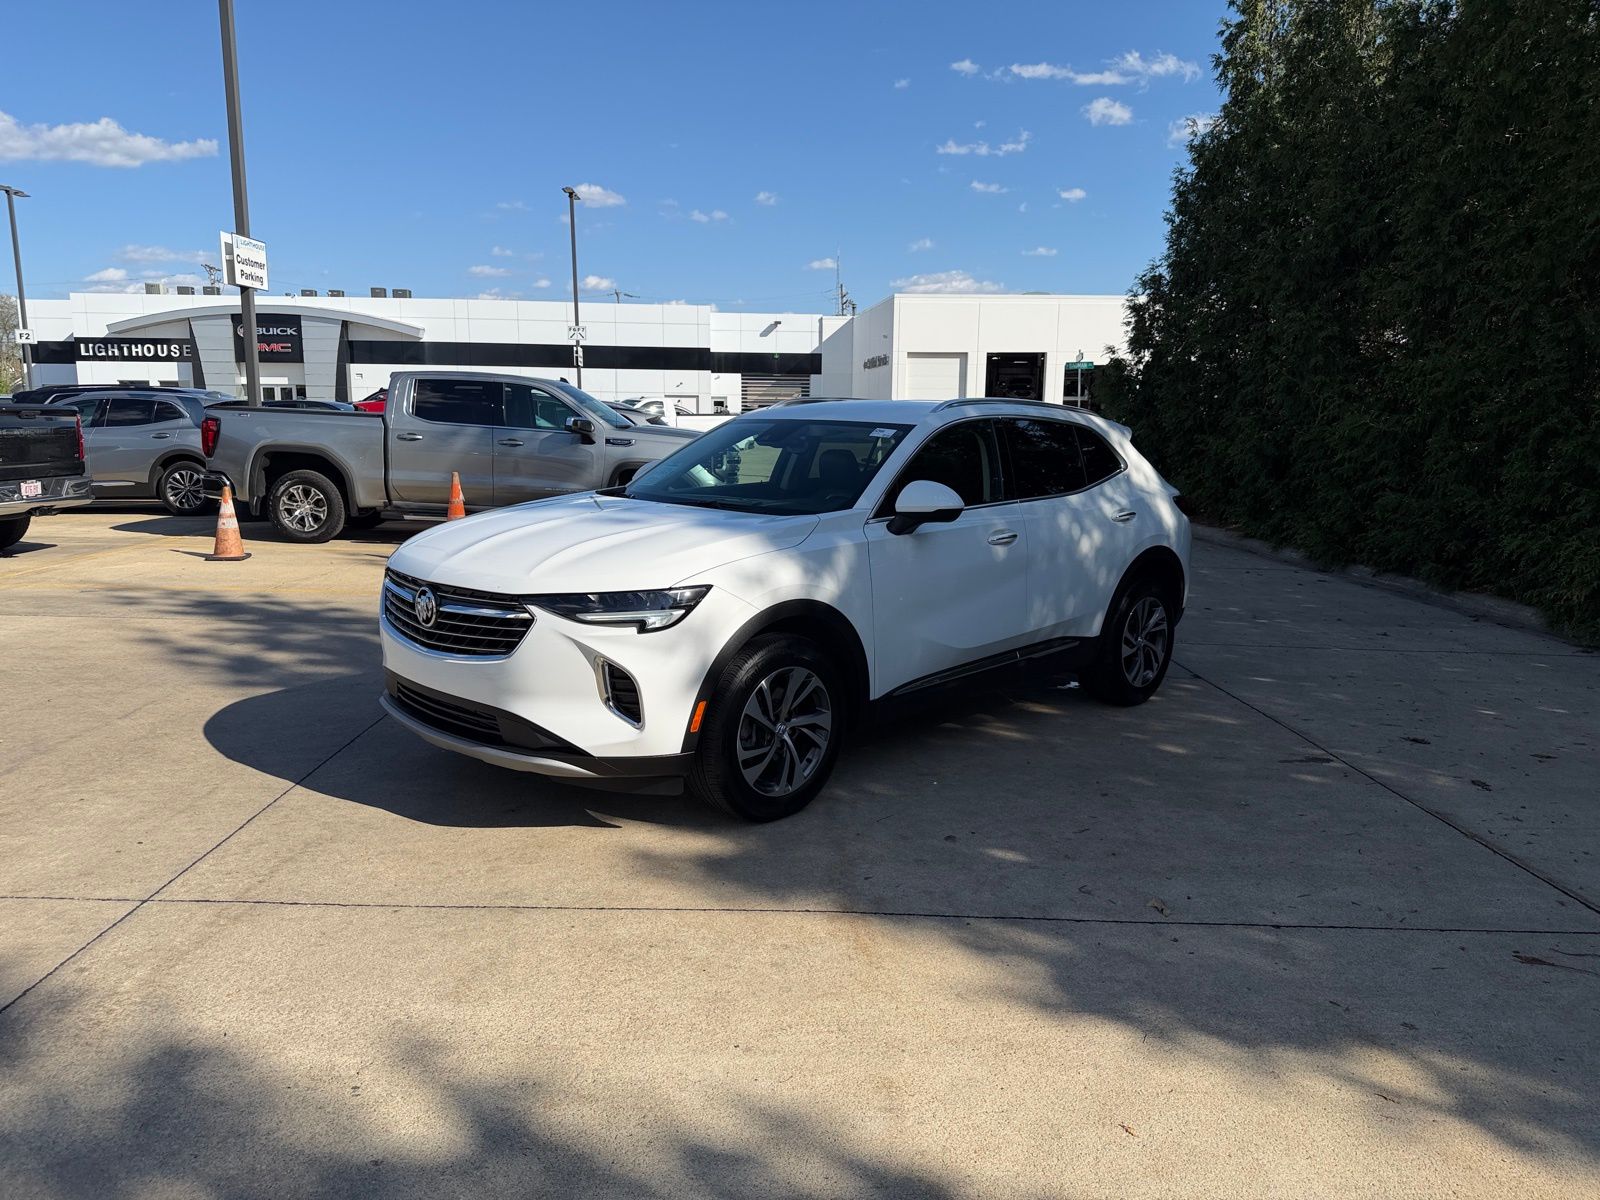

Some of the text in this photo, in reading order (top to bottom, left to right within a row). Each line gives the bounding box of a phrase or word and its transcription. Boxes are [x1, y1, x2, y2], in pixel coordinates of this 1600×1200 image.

[236, 253, 266, 270] Customer
[240, 269, 264, 286] Parking
[19, 332, 31, 340] F2
[256, 327, 298, 335] BUICK
[80, 343, 192, 357] LIGHTHOUSE
[257, 343, 292, 352] MC
